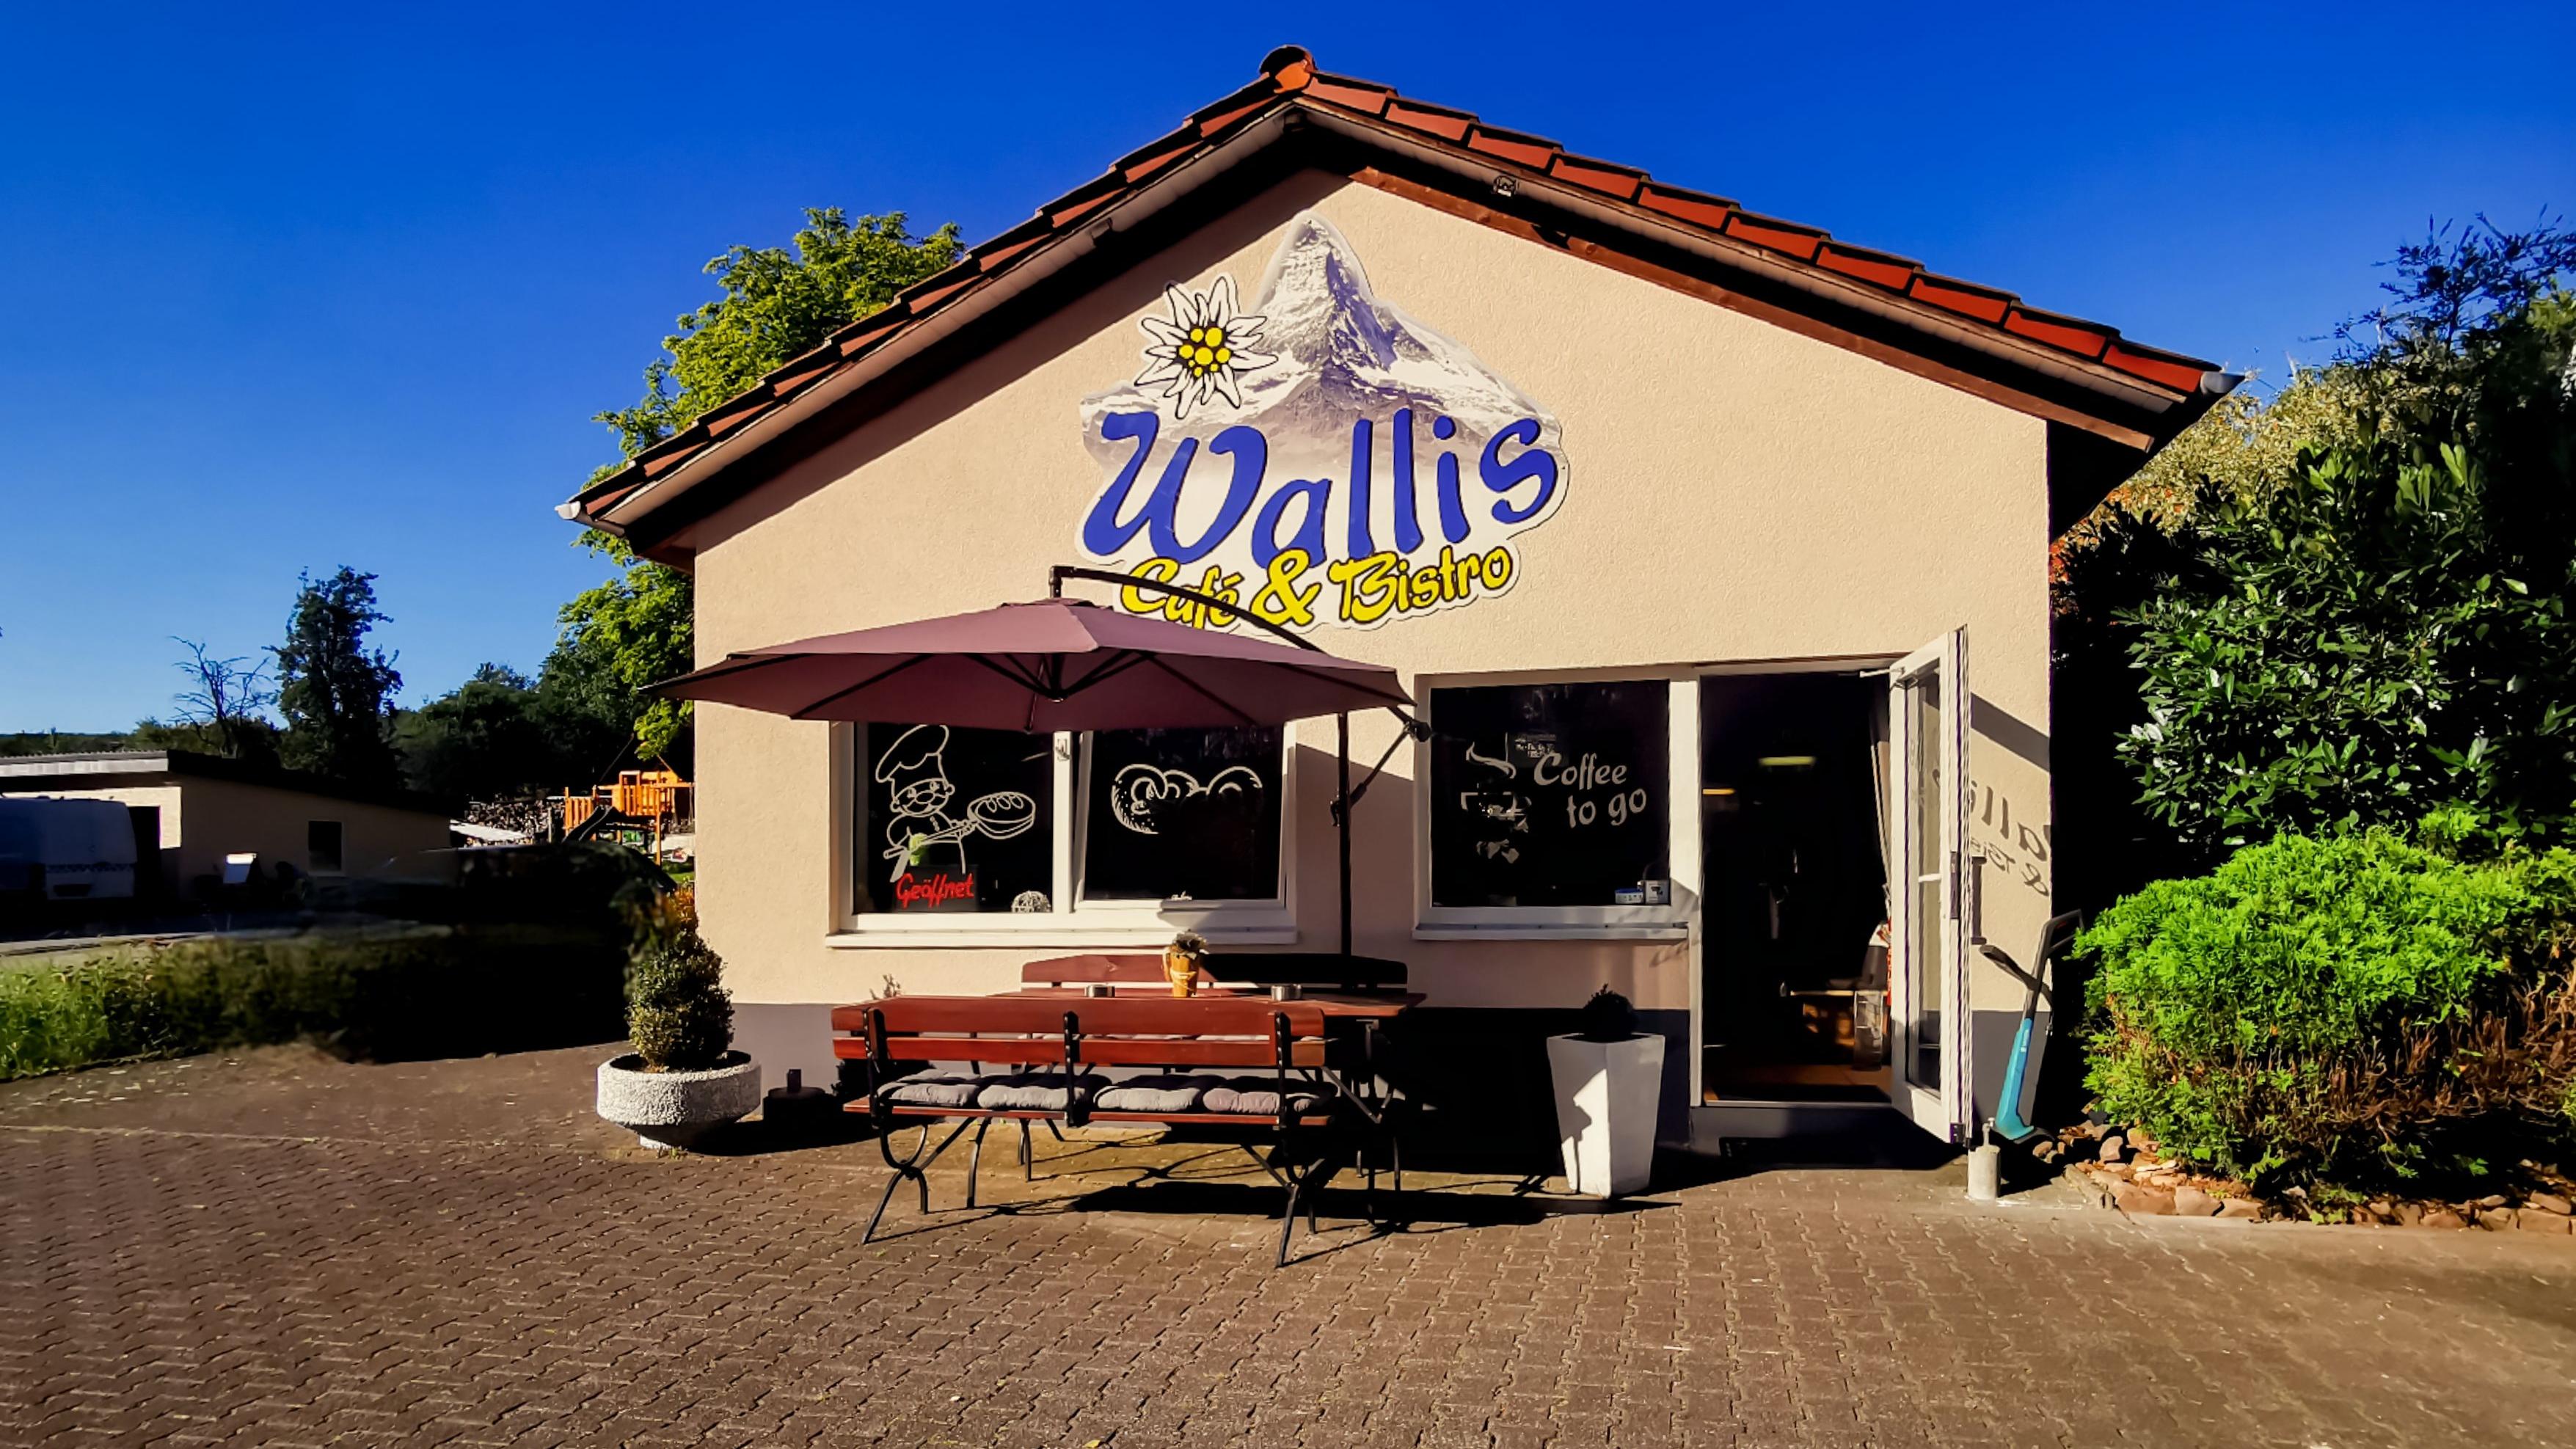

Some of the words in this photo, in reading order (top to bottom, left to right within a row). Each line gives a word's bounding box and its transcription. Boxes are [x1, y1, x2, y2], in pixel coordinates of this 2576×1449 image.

[1083, 408, 1558, 570] Wallis
[1120, 556, 1245, 629] Café
[1251, 548, 1322, 627] &
[1327, 544, 1514, 622] Bistro
[1534, 753, 1627, 790] Coffee
[1566, 795, 1597, 828] to
[1608, 788, 1647, 827] go
[897, 872, 974, 908] Geöffnet
